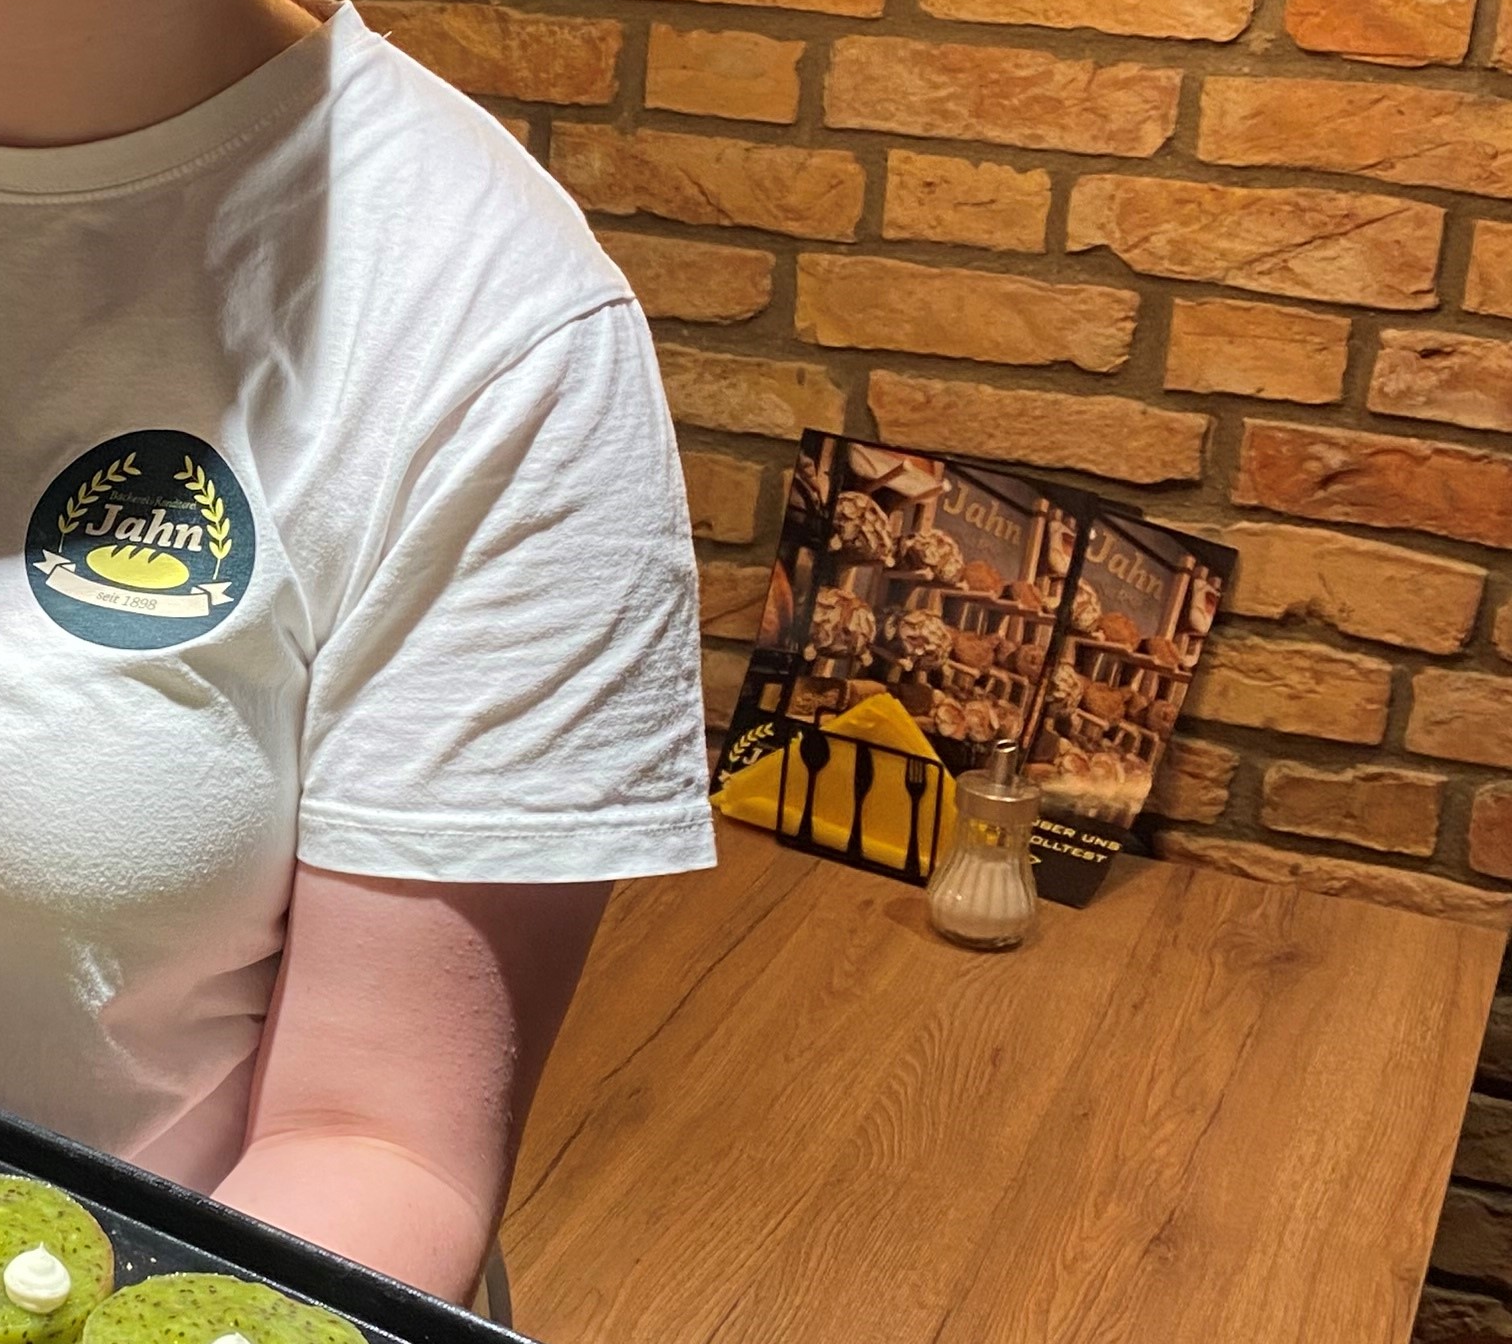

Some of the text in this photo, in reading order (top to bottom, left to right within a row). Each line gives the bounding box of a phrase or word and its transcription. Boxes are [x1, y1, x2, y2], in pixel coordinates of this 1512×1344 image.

[85, 504, 203, 552] Jahn
[942, 479, 1022, 545] Jahn
[1085, 528, 1166, 599] Jahn
[96, 590, 158, 611] seit 1898
[1029, 836, 1108, 863] OLLTEST
[1082, 834, 1122, 852] UNS
